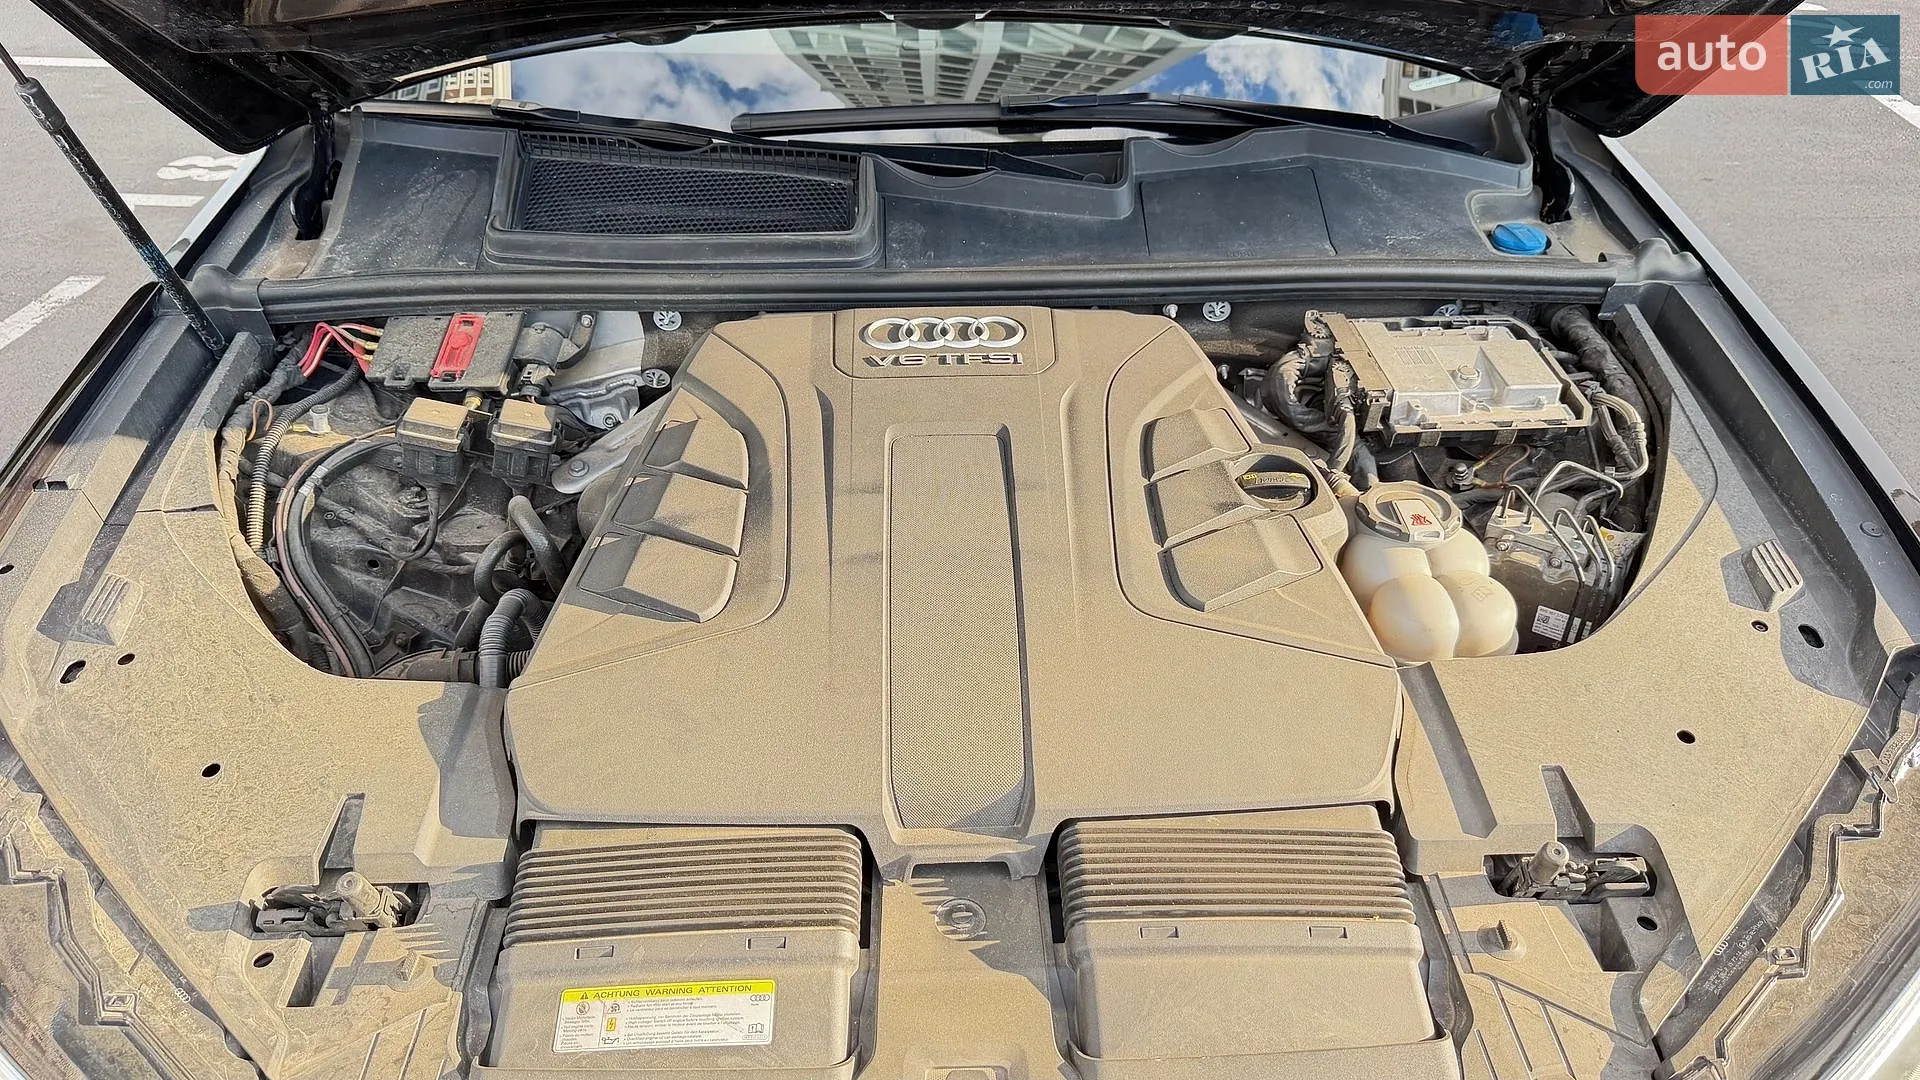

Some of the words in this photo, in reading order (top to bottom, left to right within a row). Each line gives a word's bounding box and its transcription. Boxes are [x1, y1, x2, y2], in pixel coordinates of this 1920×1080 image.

[935, 352, 1023, 366] TFSI
[593, 990, 640, 999] ACHTUNG
[645, 986, 693, 997] WARNING
[698, 984, 752, 994] ATTENTION
